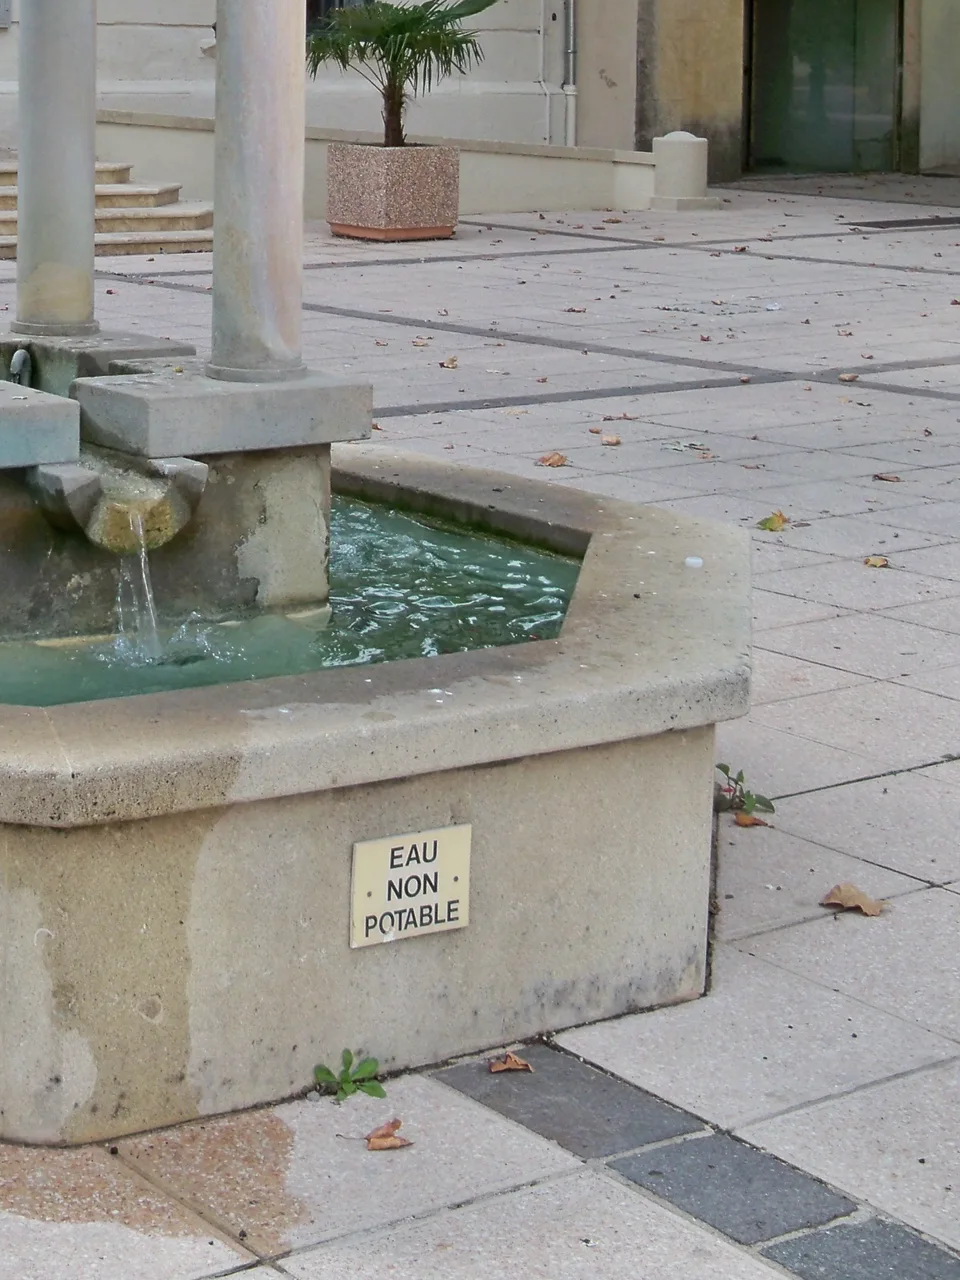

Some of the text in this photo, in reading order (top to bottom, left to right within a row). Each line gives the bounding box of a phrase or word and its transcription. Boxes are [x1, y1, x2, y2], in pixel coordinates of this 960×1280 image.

[390, 840, 438, 869] EAU
[387, 871, 438, 901] NON
[365, 899, 459, 937] POTABLE
